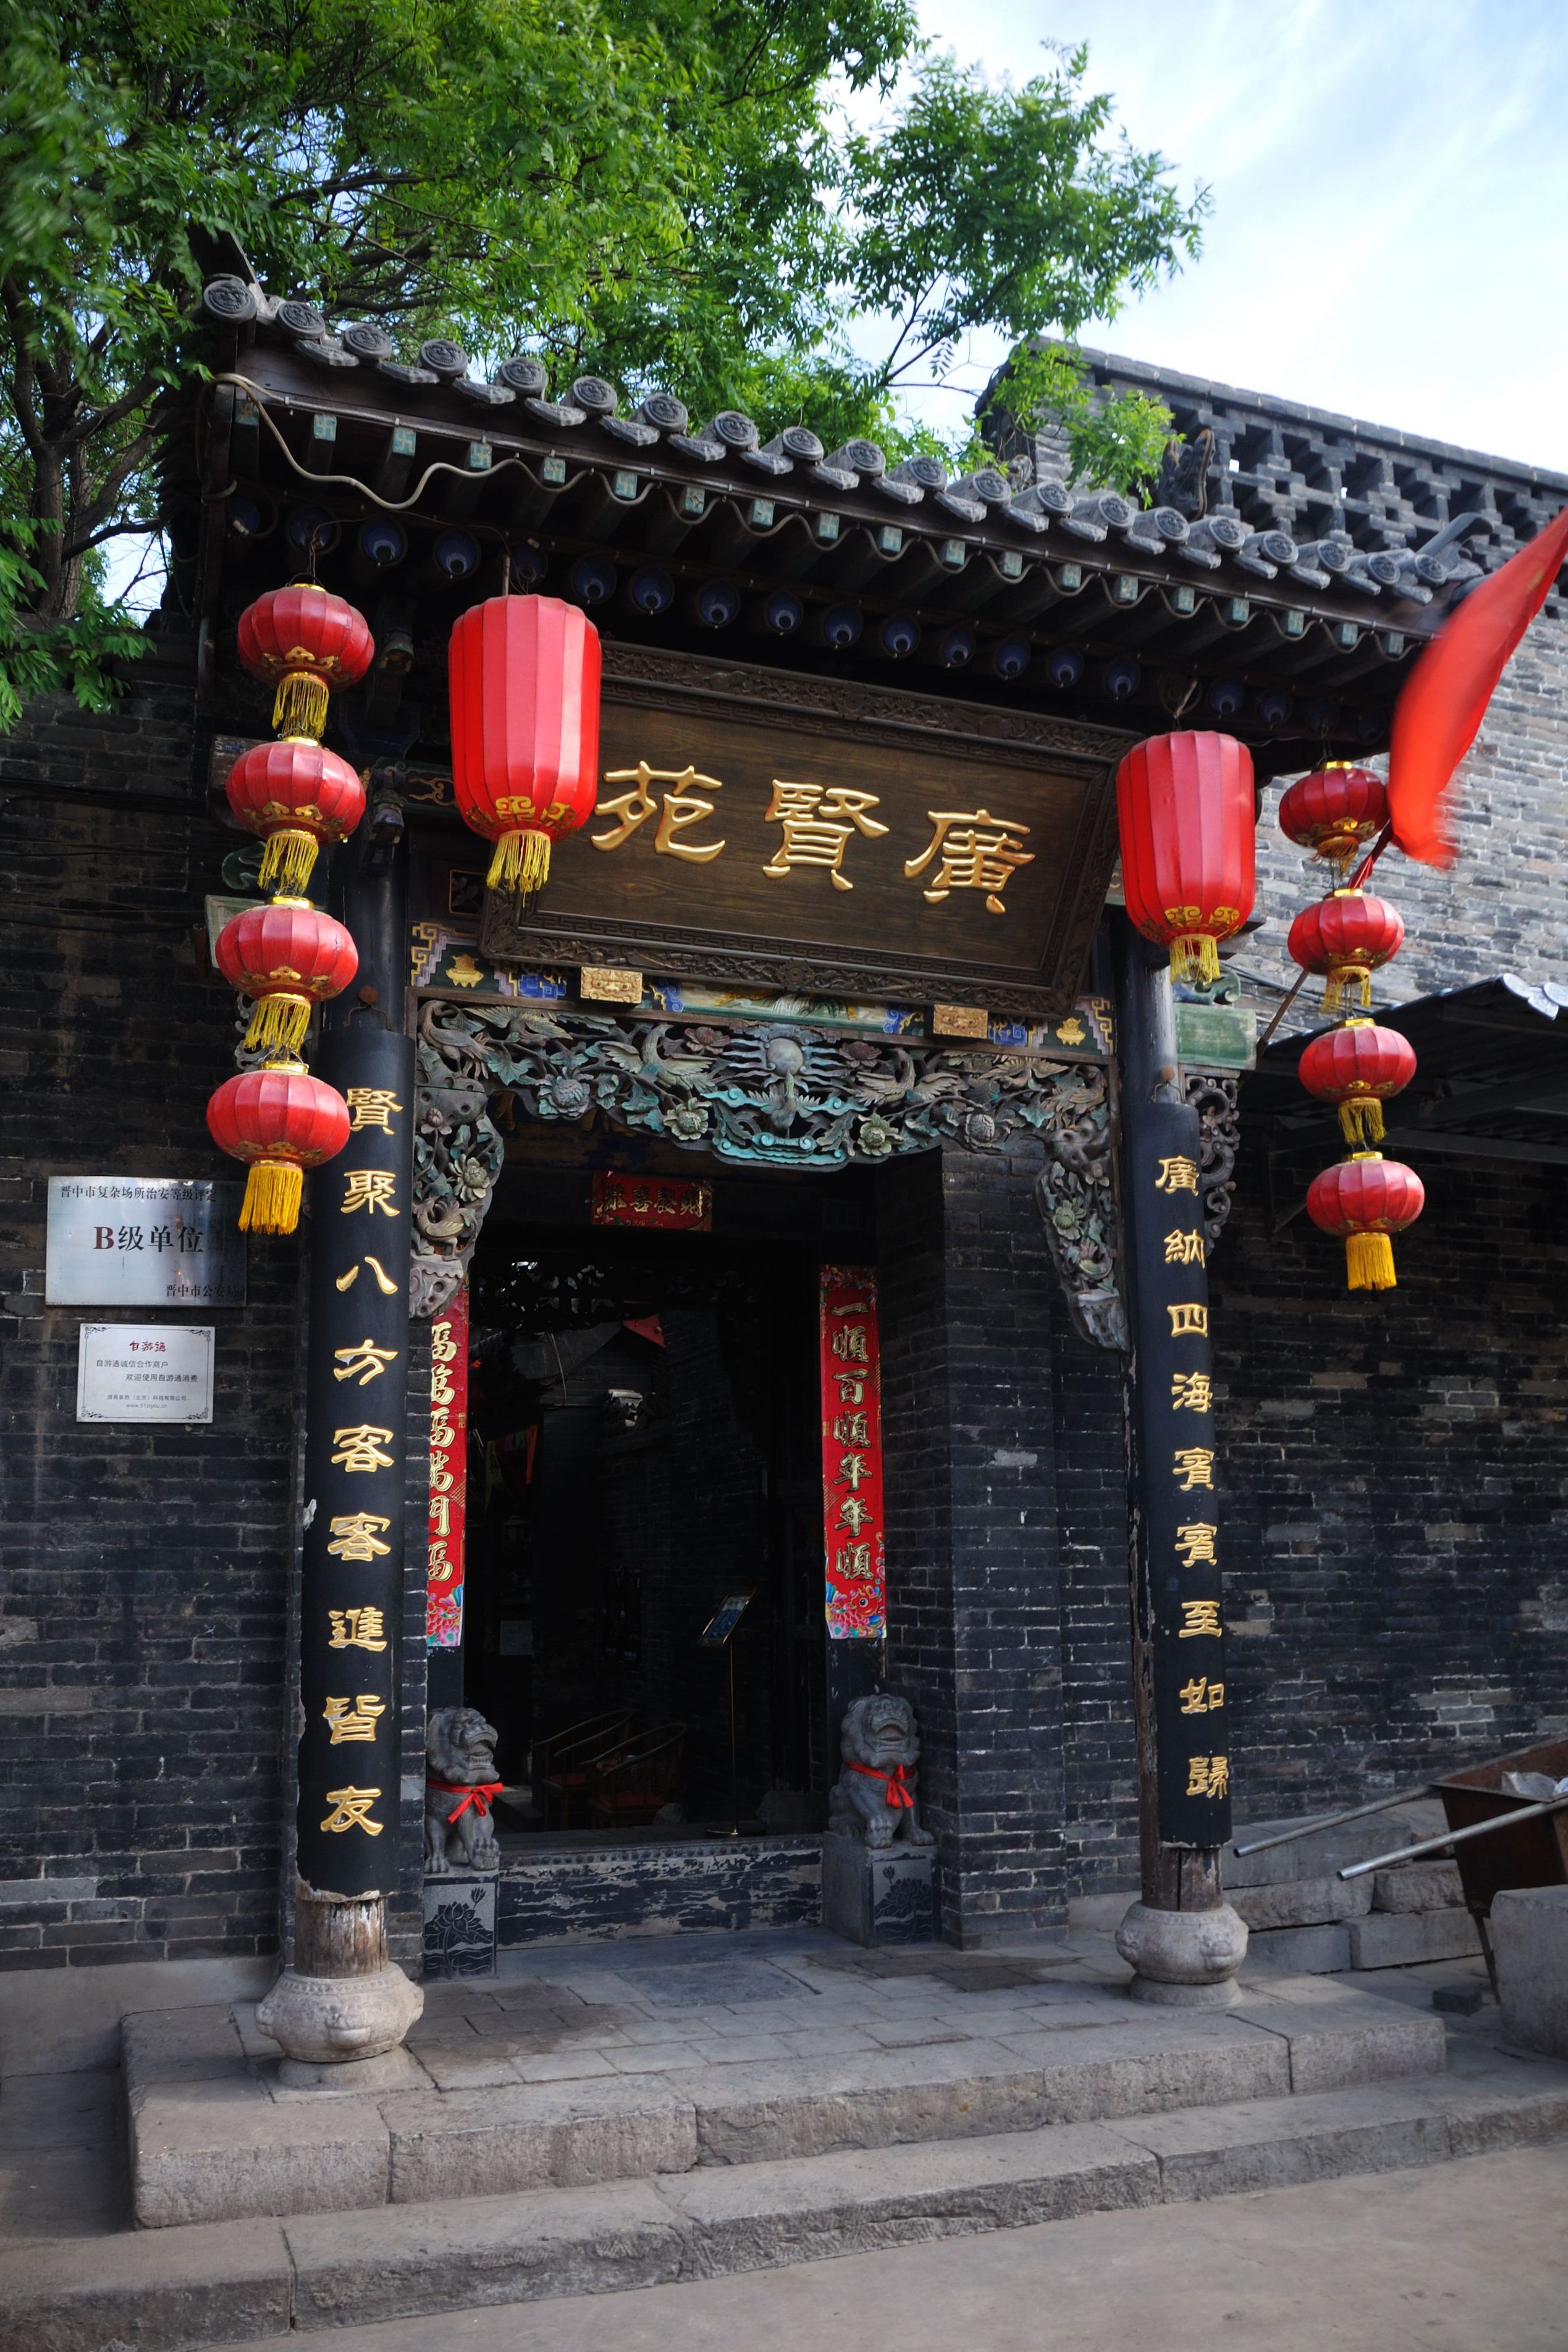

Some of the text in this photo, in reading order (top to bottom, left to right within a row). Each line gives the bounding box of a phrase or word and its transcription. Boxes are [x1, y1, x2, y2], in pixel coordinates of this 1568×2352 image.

[60, 1186, 217, 1203] 晋中市复杂场所治安等级评定
[93, 1225, 204, 1253] B级单位
[166, 1284, 237, 1297] 晋中市公安局
[129, 1341, 166, 1352] 自游通
[96, 1359, 169, 1369] 自游通诚信合作商户
[126, 1374, 198, 1383] 欢迎使用自游通消费
